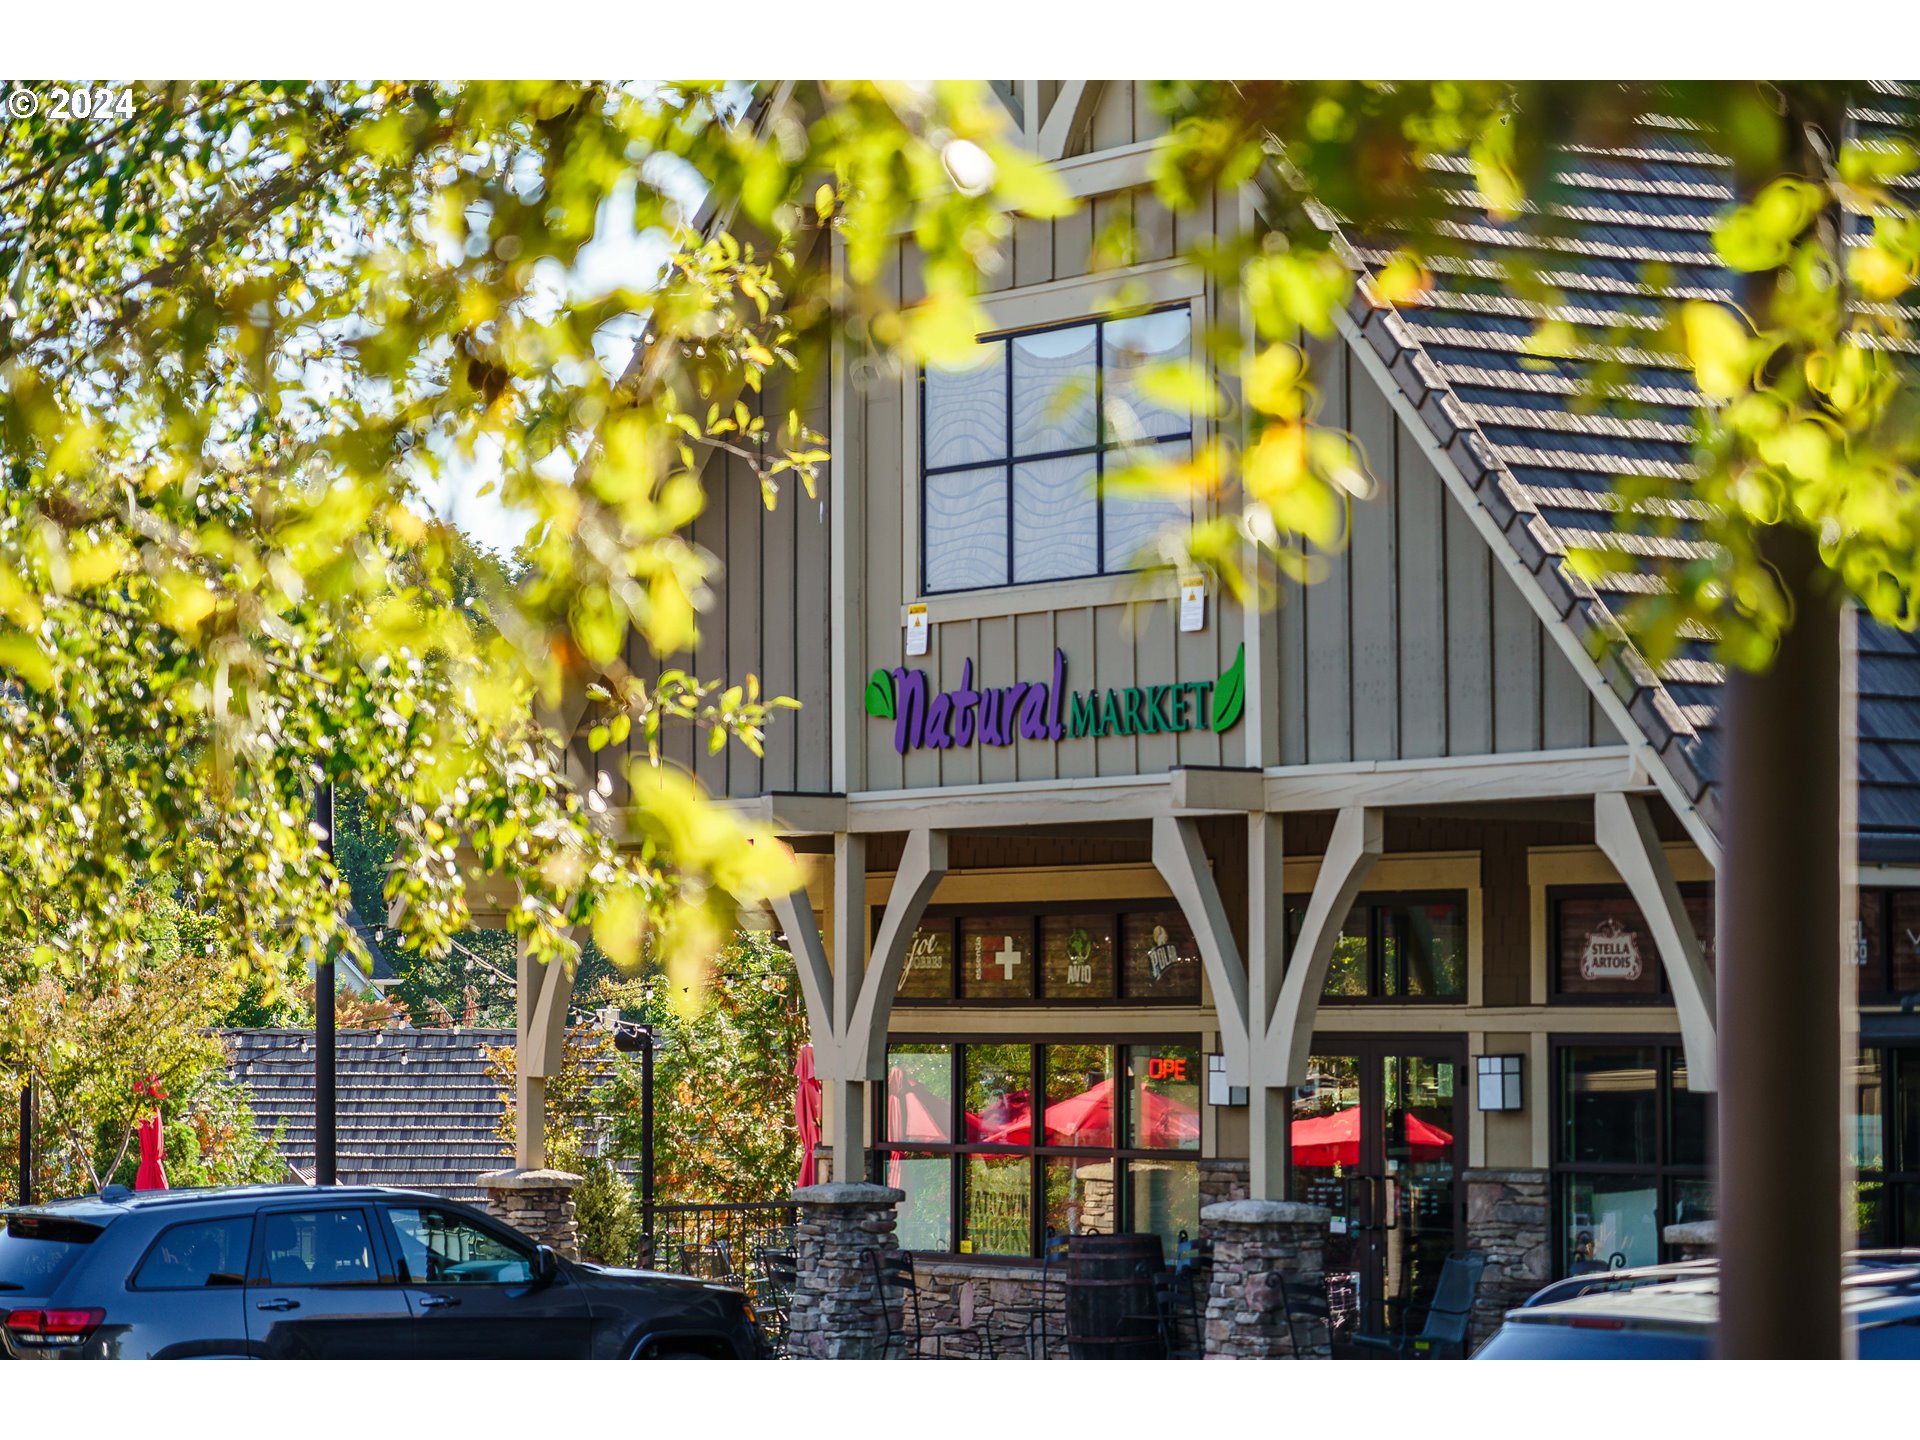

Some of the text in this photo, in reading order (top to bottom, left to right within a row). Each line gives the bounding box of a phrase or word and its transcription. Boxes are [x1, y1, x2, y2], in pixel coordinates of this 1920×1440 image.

[1068, 680, 1214, 739] MARKET
[1592, 943, 1630, 955] STELLA
[1592, 957, 1631, 969] ARTOIS
